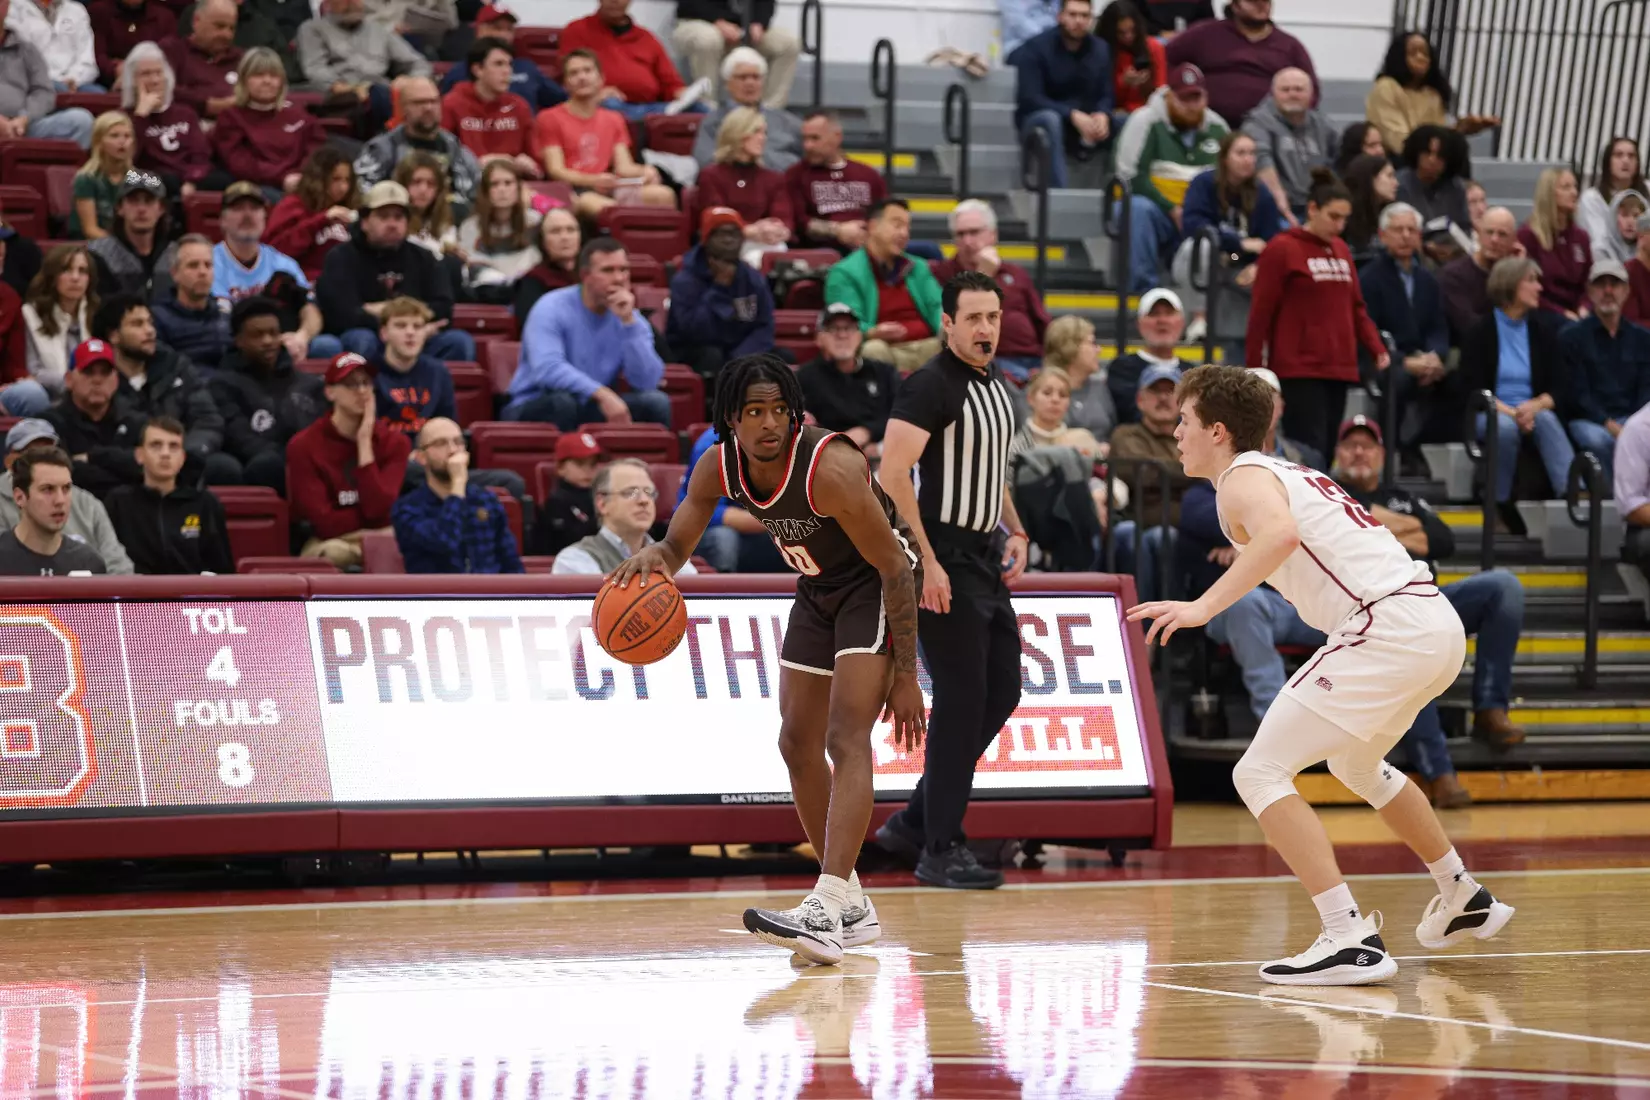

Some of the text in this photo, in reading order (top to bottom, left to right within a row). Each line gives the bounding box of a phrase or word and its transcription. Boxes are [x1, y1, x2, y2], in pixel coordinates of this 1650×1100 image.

[761, 516, 822, 541] OWN
[182, 607, 248, 635] TOL
[619, 611, 651, 642] THE
[206, 646, 241, 688] 4
[173, 699, 281, 726] FOULS
[217, 742, 255, 788] 8
